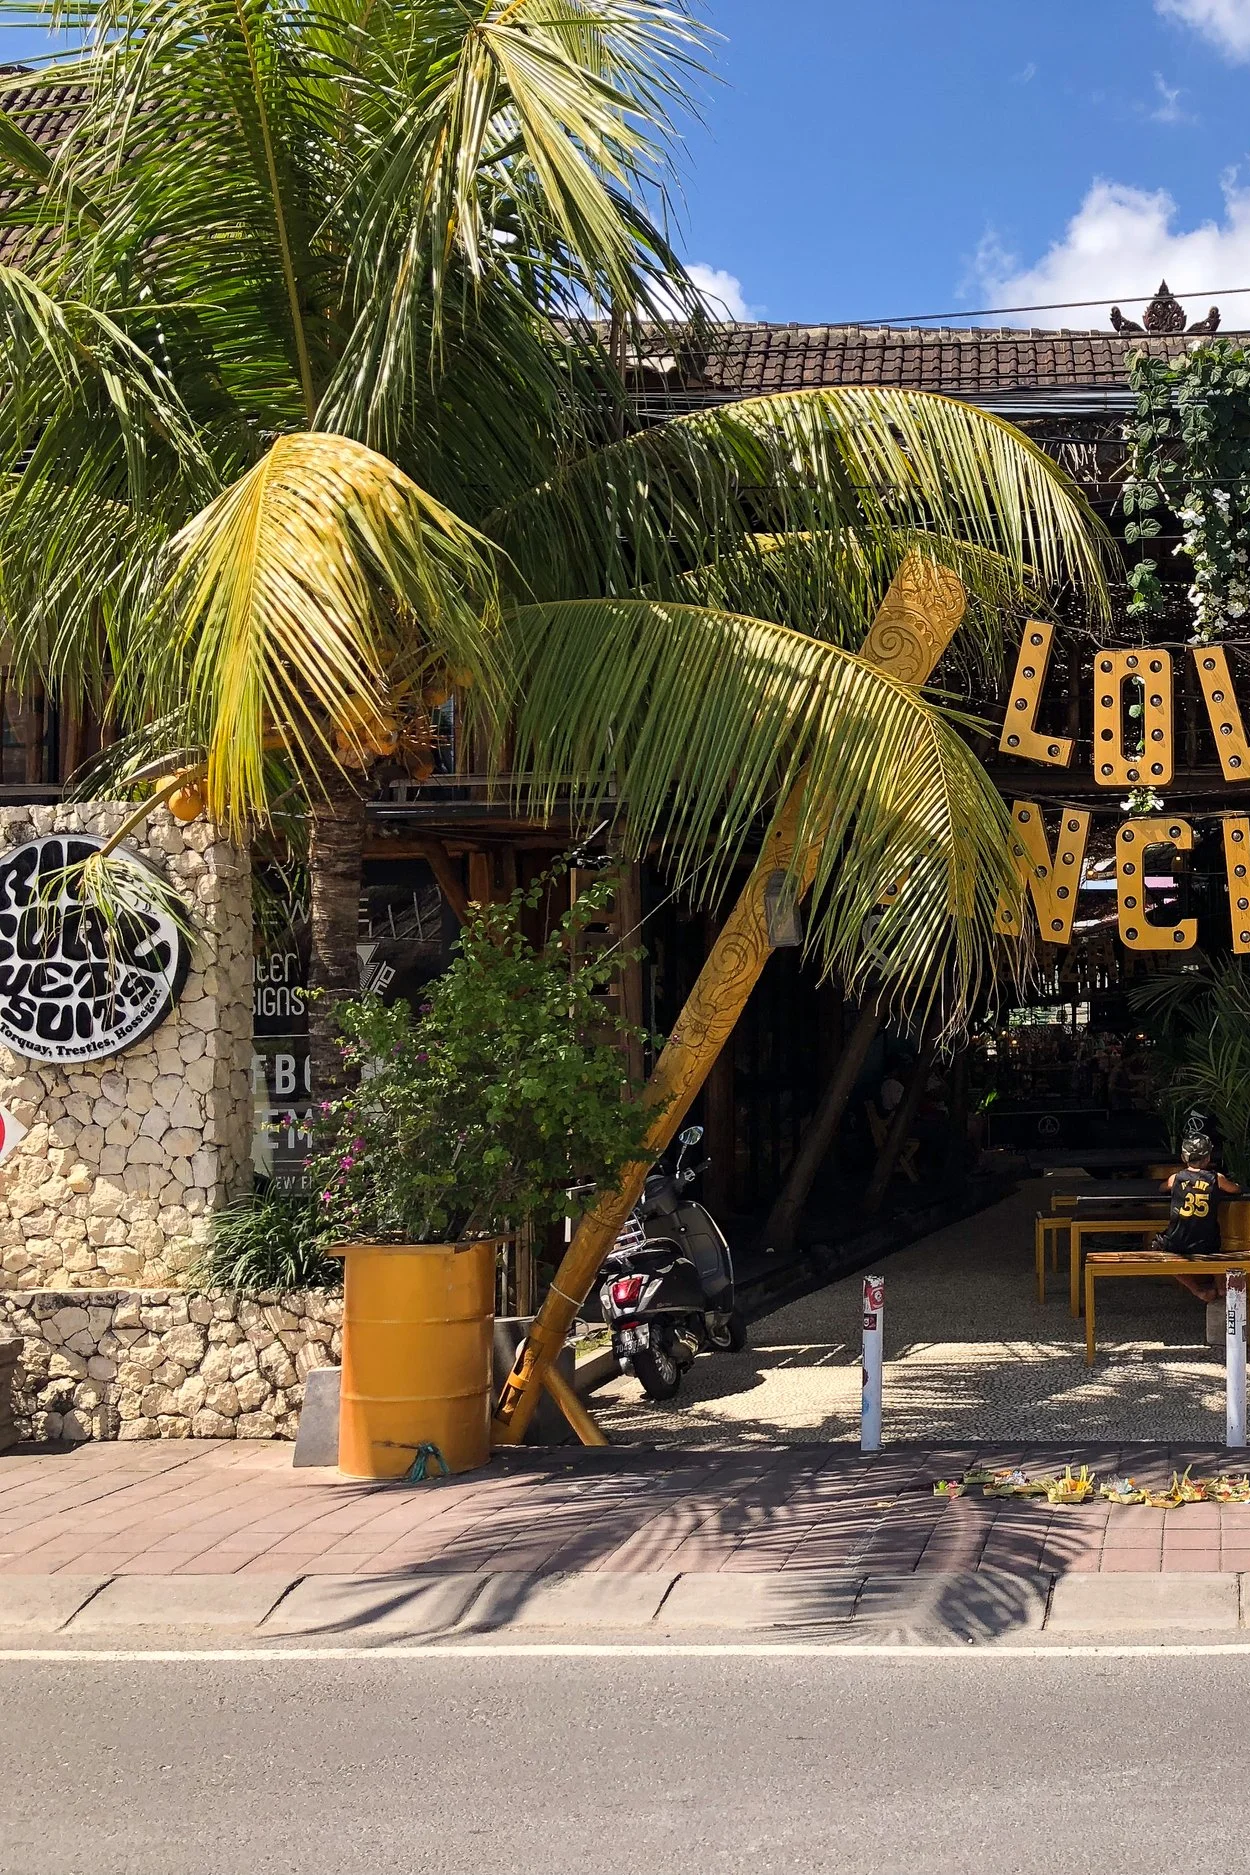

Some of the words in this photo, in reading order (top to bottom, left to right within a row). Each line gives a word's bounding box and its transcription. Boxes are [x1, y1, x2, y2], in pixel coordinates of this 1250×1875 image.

[56, 1037, 115, 1056] Trestles,
[113, 988, 163, 1040] Hossegor.
[1180, 1192, 1210, 1217] 35
